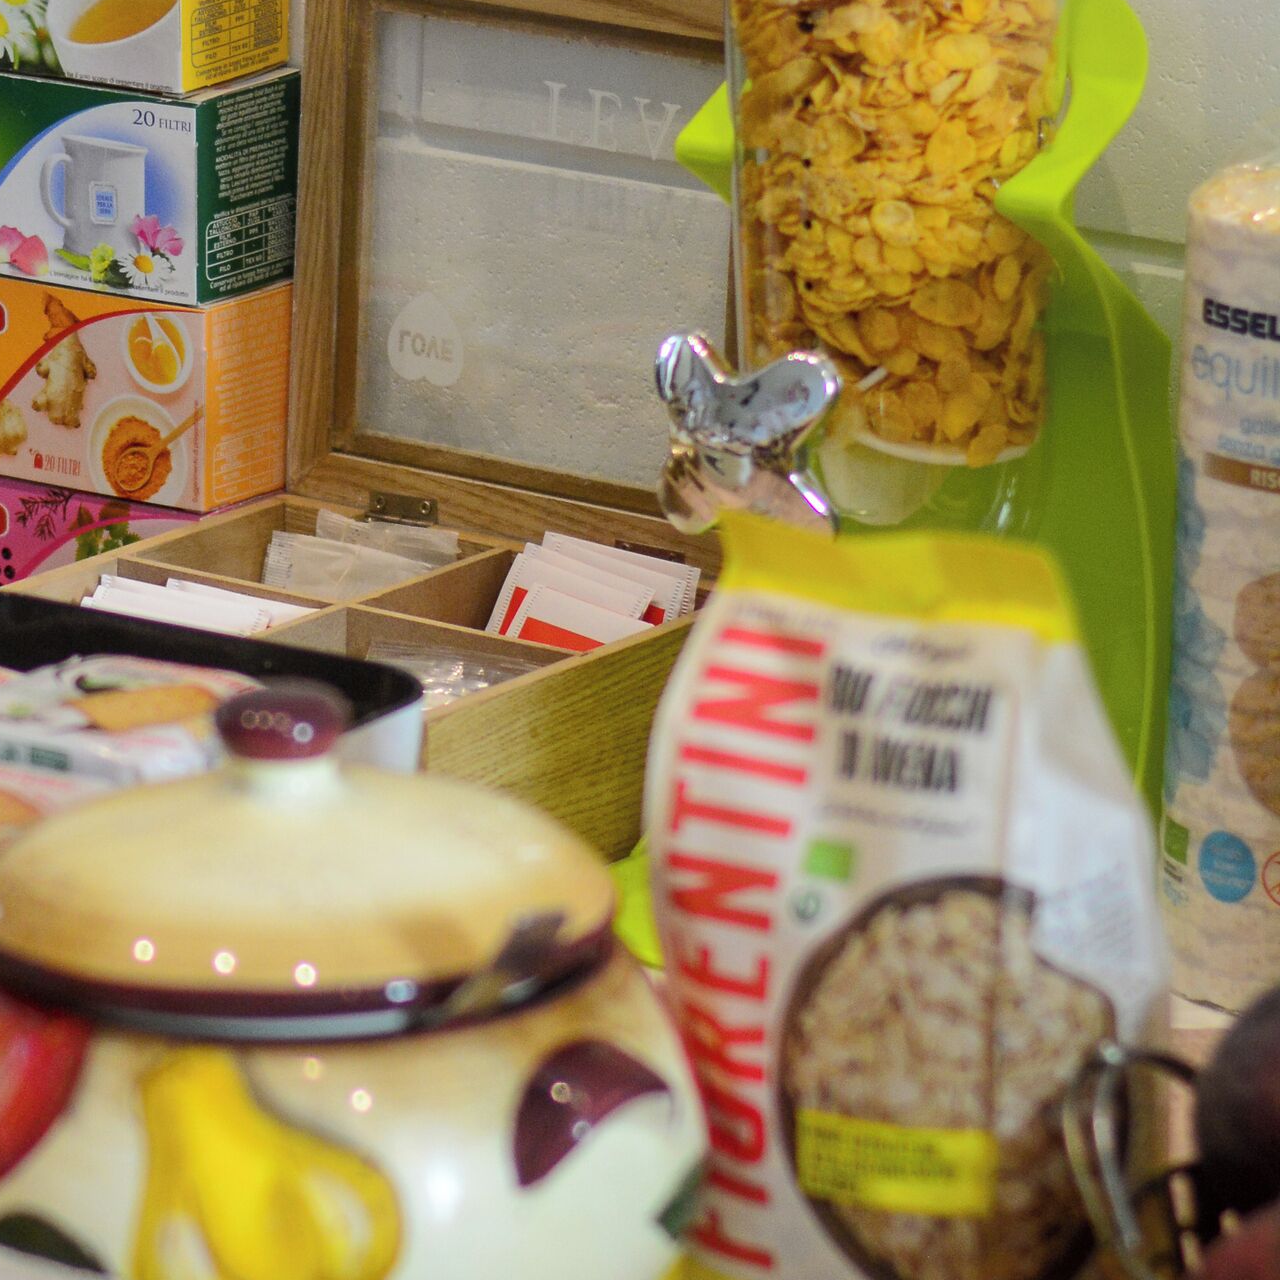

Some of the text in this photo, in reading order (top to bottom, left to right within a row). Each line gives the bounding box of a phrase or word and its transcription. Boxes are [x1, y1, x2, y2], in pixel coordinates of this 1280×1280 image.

[132, 108, 191, 132] 20 FILTRI
[1203, 298, 1280, 342] ESSEL
[44, 454, 80, 477] 20 FILTRI
[1249, 468, 1280, 490] RIS
